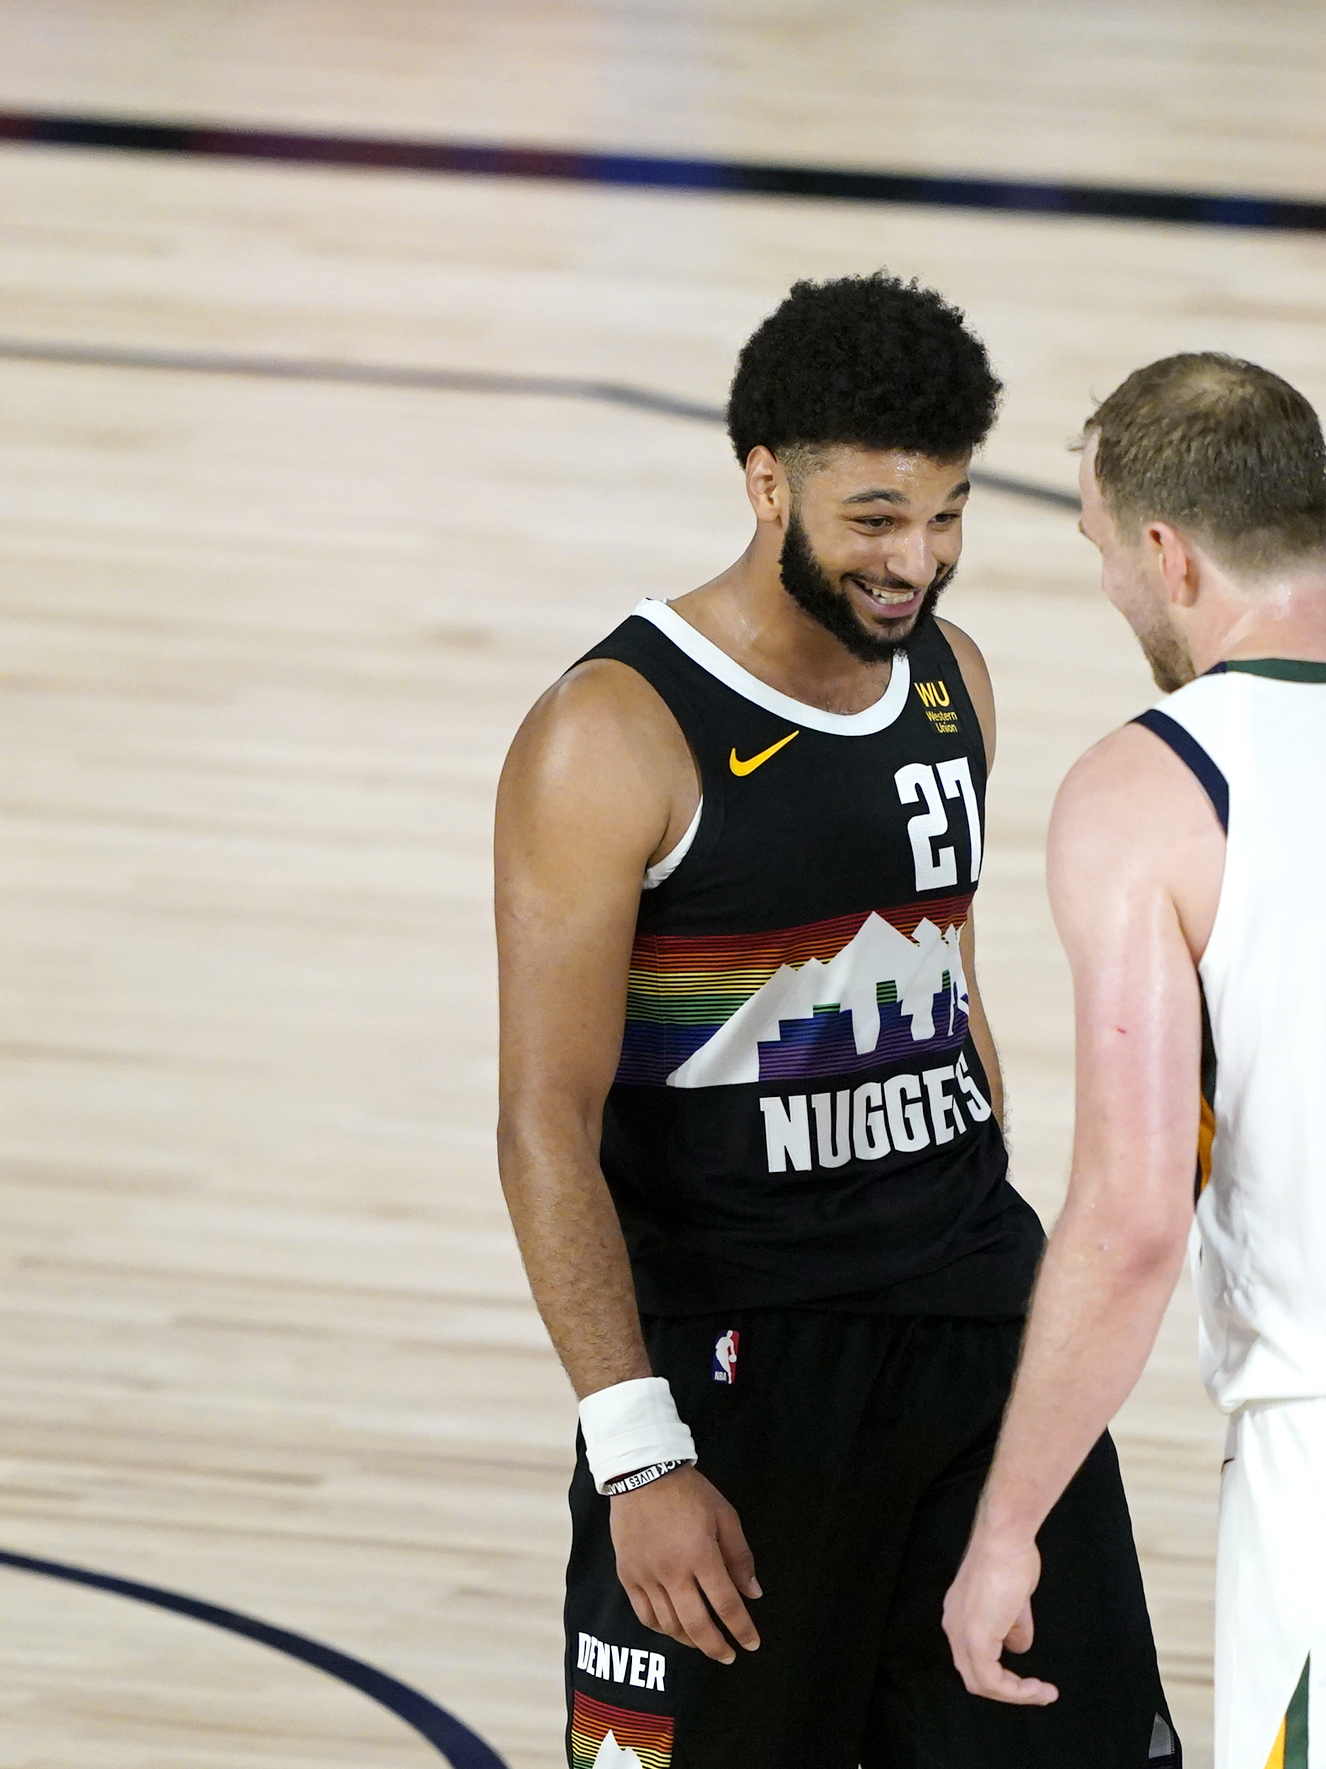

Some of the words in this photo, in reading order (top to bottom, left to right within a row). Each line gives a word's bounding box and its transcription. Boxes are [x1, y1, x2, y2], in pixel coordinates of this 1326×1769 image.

[914, 680, 950, 708] WU
[925, 711, 958, 722] Western
[935, 722, 958, 733] Union
[894, 756, 981, 892] 27
[630, 1468, 655, 1488] LIVES
[577, 1631, 666, 1692] DENVER
